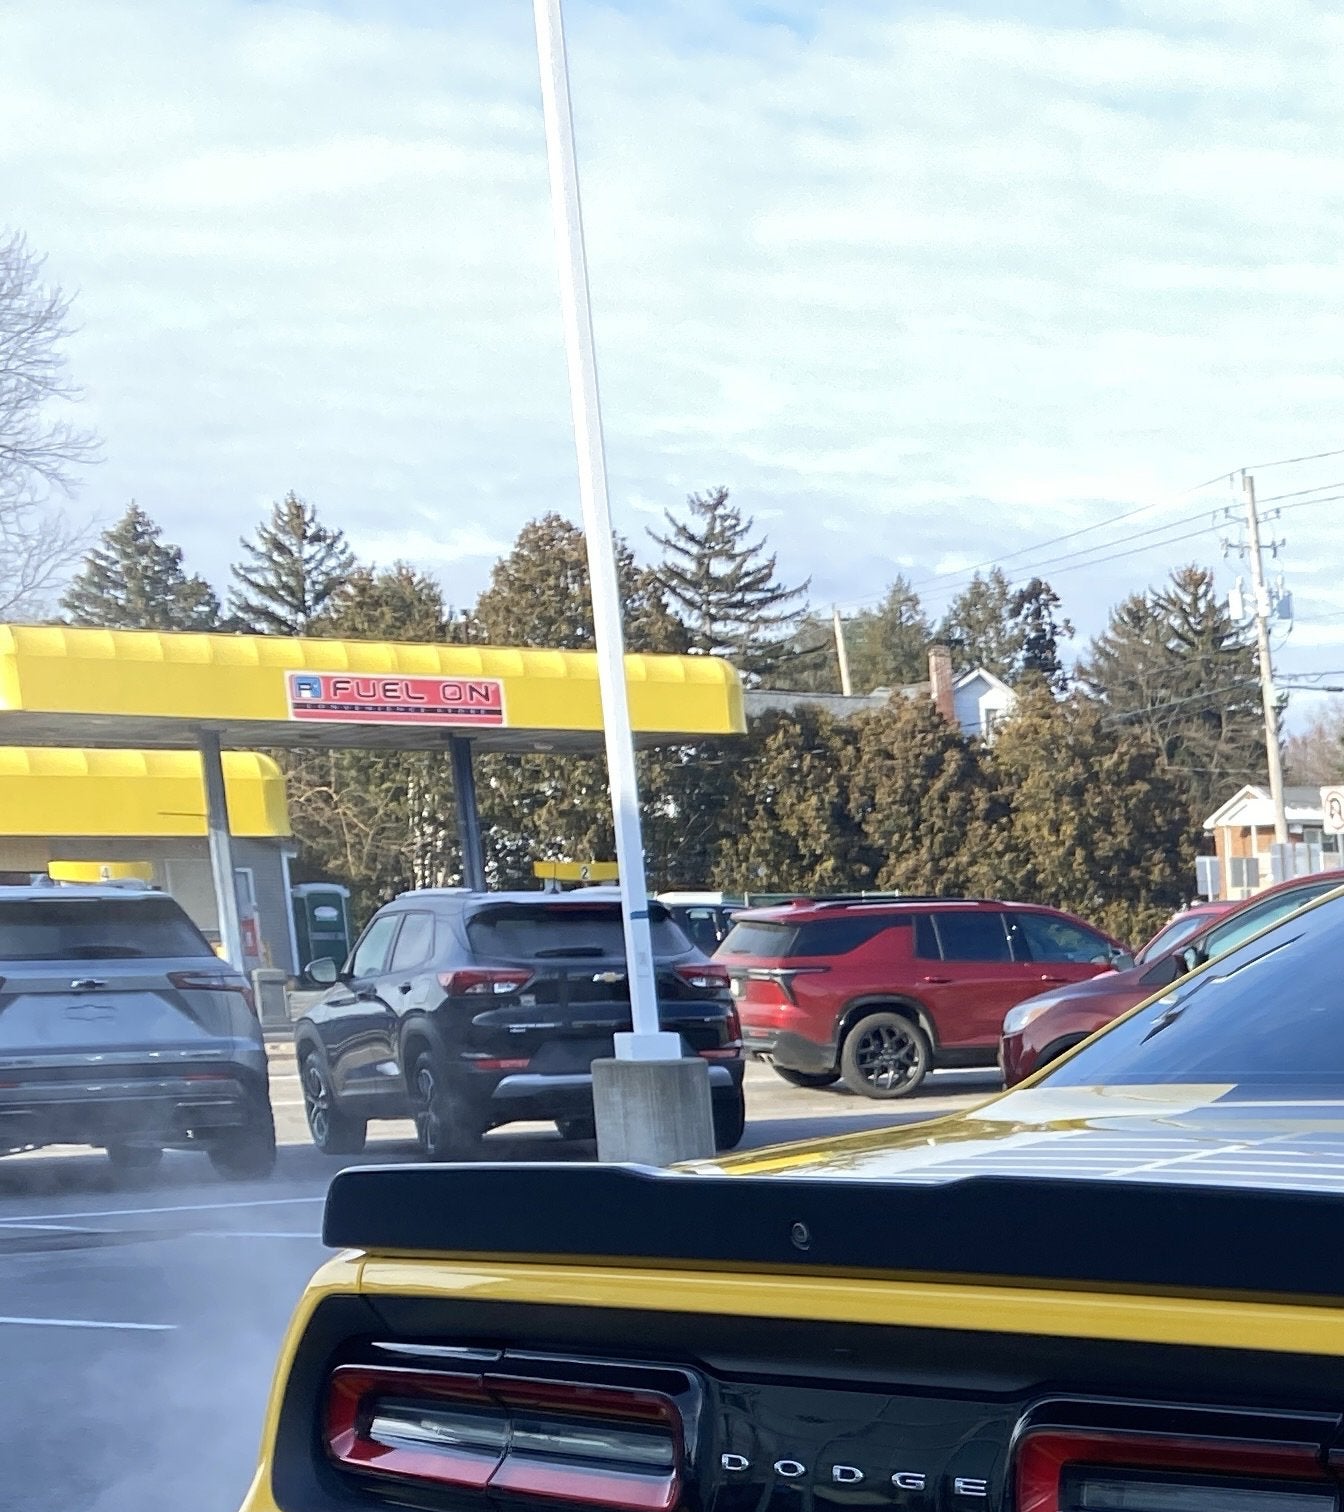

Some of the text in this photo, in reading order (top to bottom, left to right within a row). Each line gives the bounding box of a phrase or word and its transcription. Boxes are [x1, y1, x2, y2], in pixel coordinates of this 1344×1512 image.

[333, 680, 490, 702] FUEL ON
[721, 1453, 987, 1496] DODGE
